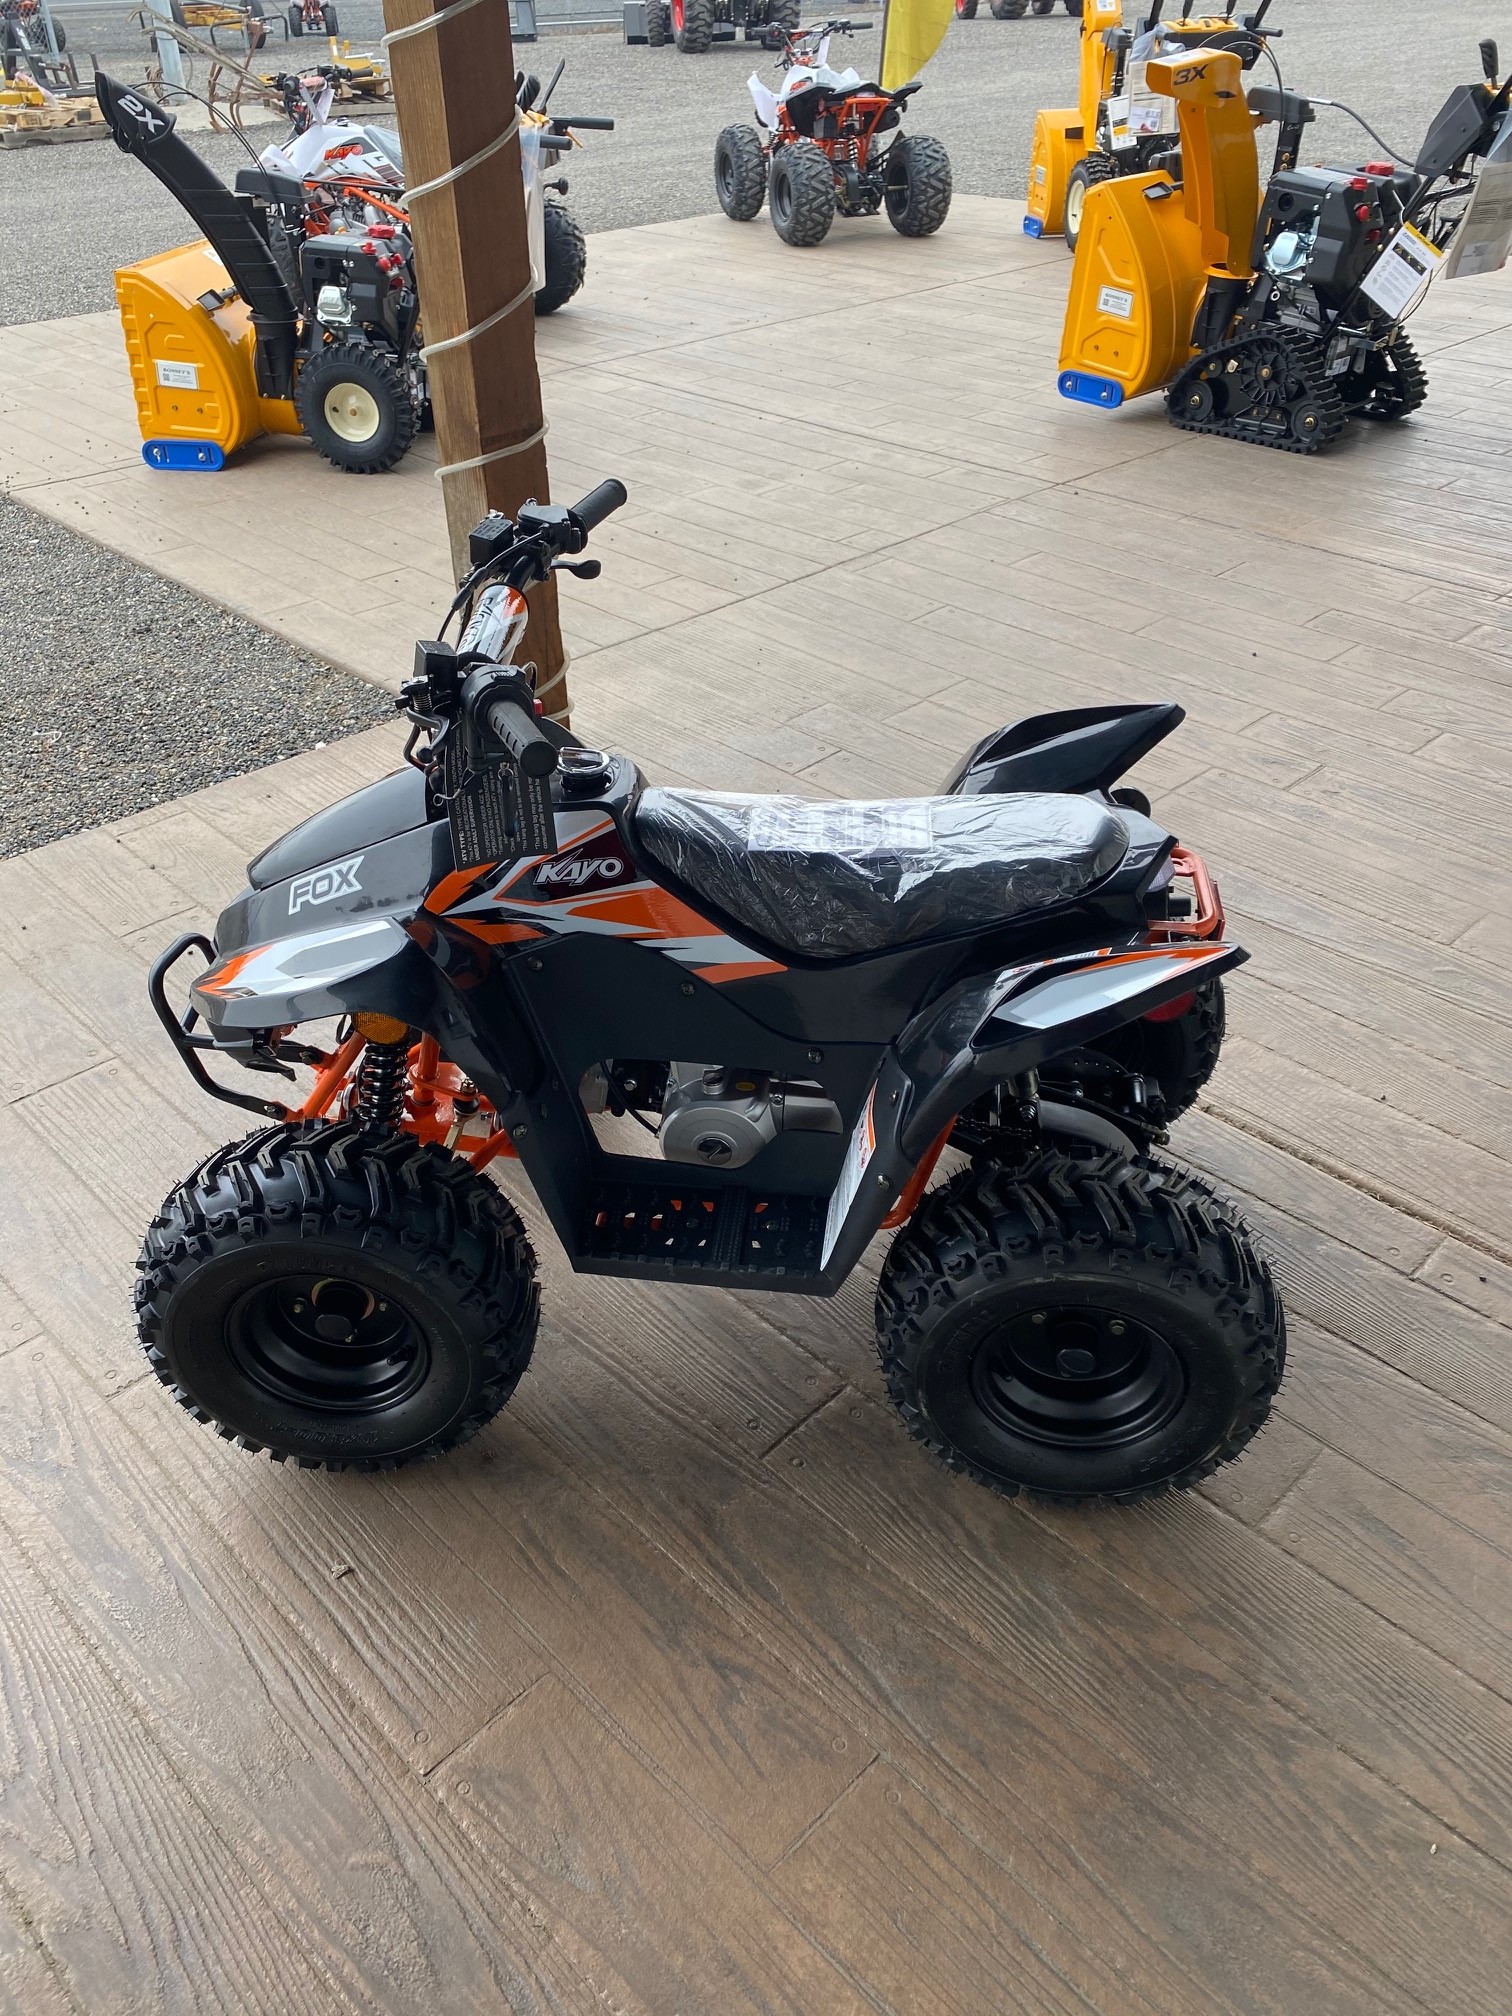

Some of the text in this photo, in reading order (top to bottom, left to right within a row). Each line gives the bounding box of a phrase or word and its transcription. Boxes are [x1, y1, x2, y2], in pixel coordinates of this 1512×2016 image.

[1173, 64, 1209, 86] 3X
[117, 94, 166, 135] 2X
[528, 792, 536, 803] only
[534, 785, 542, 804] vehicle
[466, 794, 475, 827] SUPERVISION
[482, 821, 491, 848] OPERATOR
[532, 822, 540, 836] hang
[540, 824, 548, 849] consumer
[472, 843, 480, 861] UNDER
[533, 848, 624, 887] KAYO
[288, 855, 365, 916] FOX
